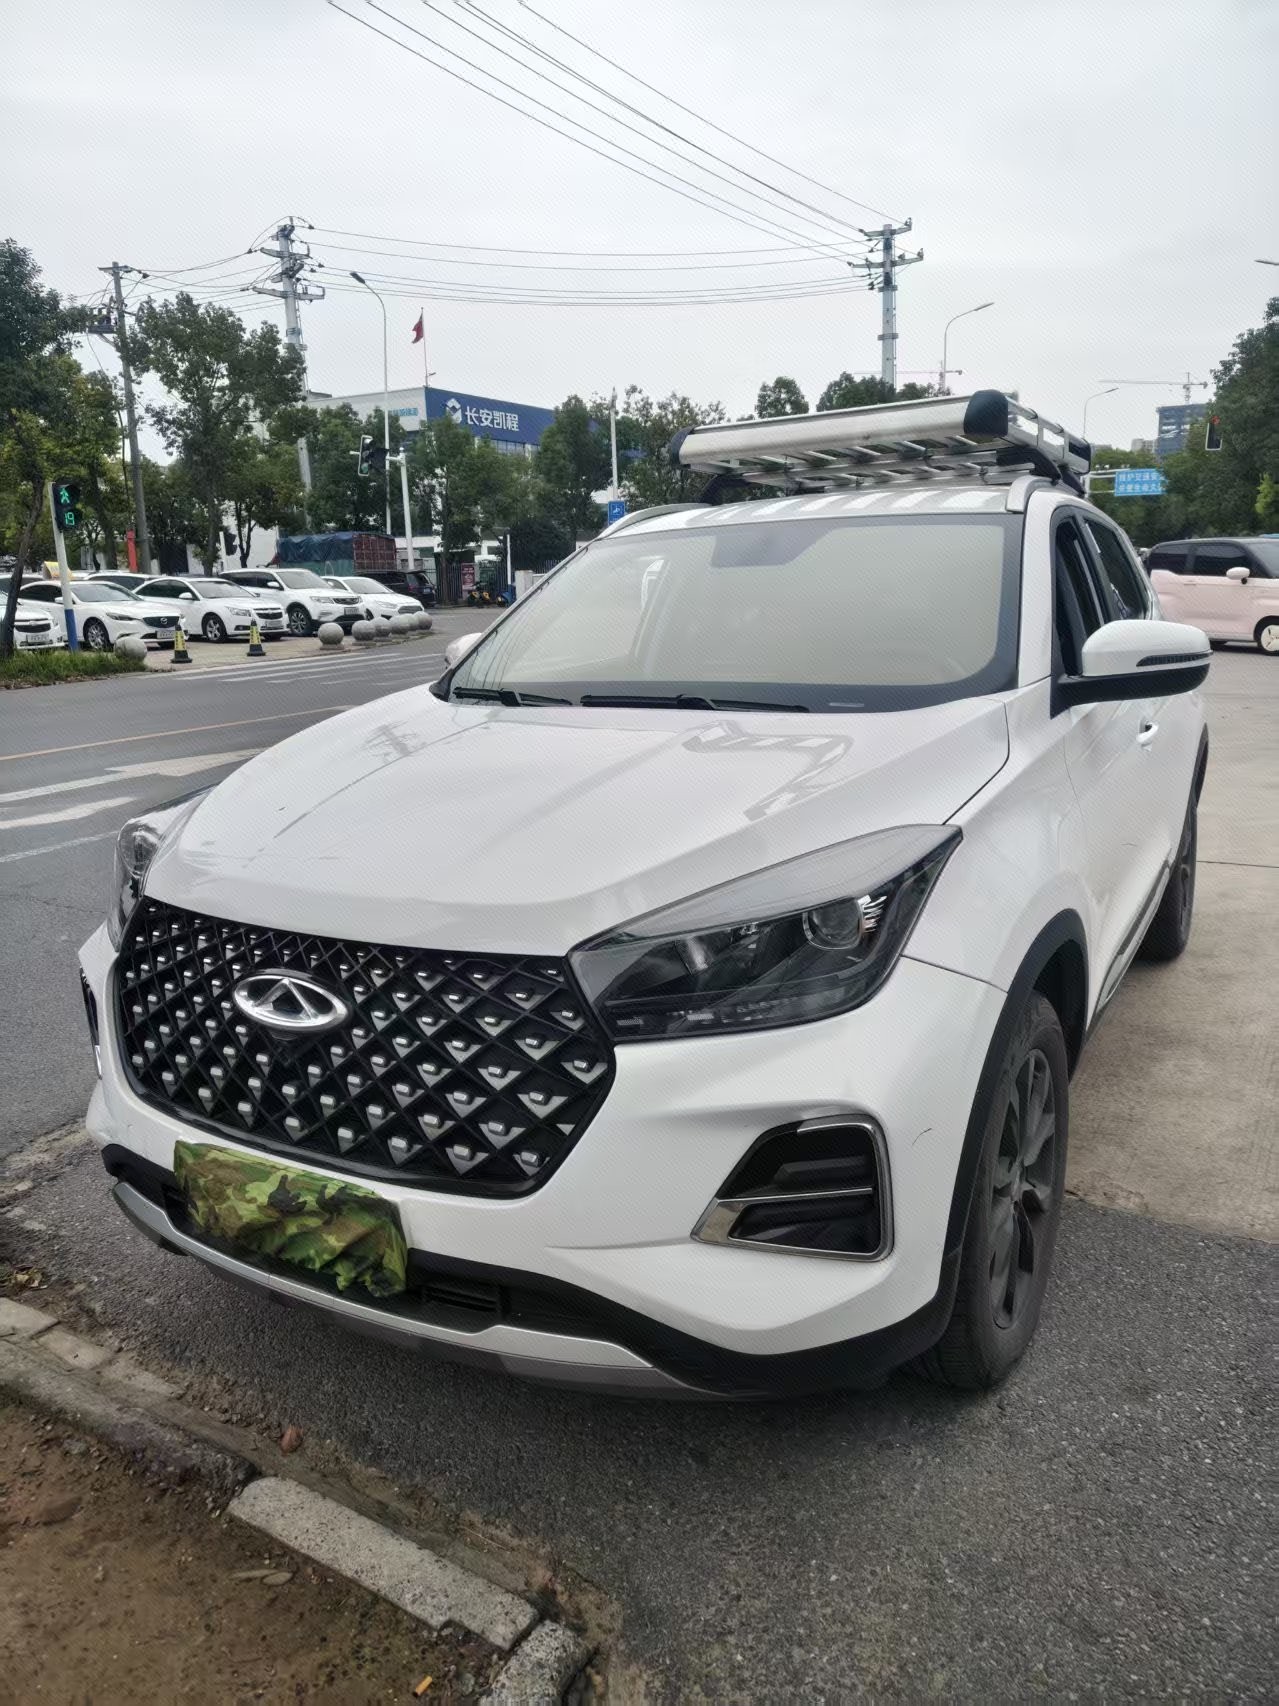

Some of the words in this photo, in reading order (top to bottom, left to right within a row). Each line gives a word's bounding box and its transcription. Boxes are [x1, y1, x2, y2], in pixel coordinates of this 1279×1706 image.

[465, 406, 520, 432] 长安凯程
[64, 511, 75, 526] 19
